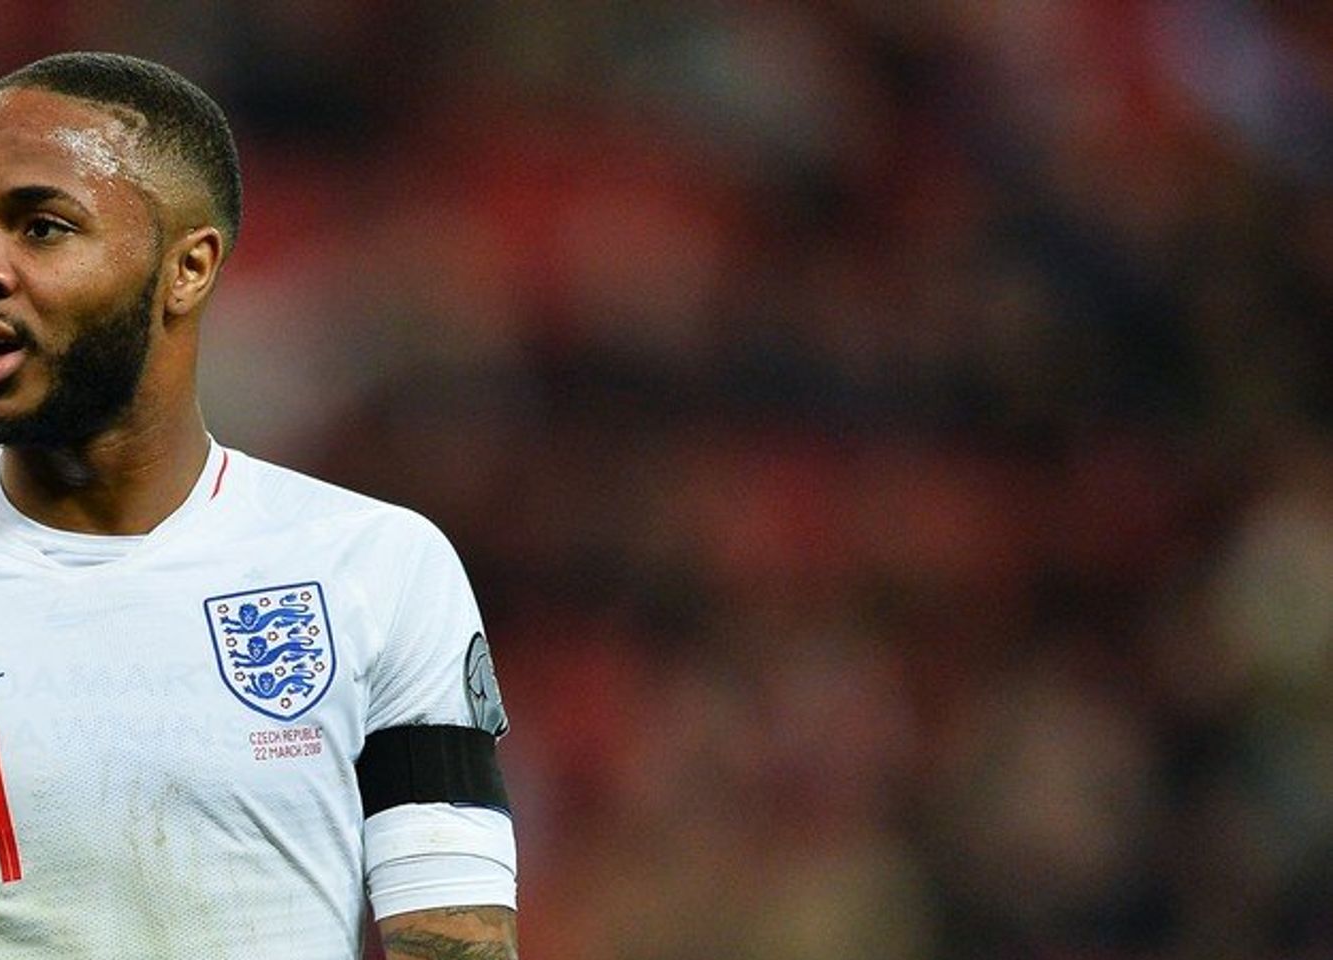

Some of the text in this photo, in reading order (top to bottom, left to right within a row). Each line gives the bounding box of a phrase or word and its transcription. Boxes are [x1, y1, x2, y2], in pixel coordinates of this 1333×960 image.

[249, 727, 323, 745] CZECH REPUBLIC
[254, 746, 267, 761] 22
[268, 744, 302, 759] MARCH
